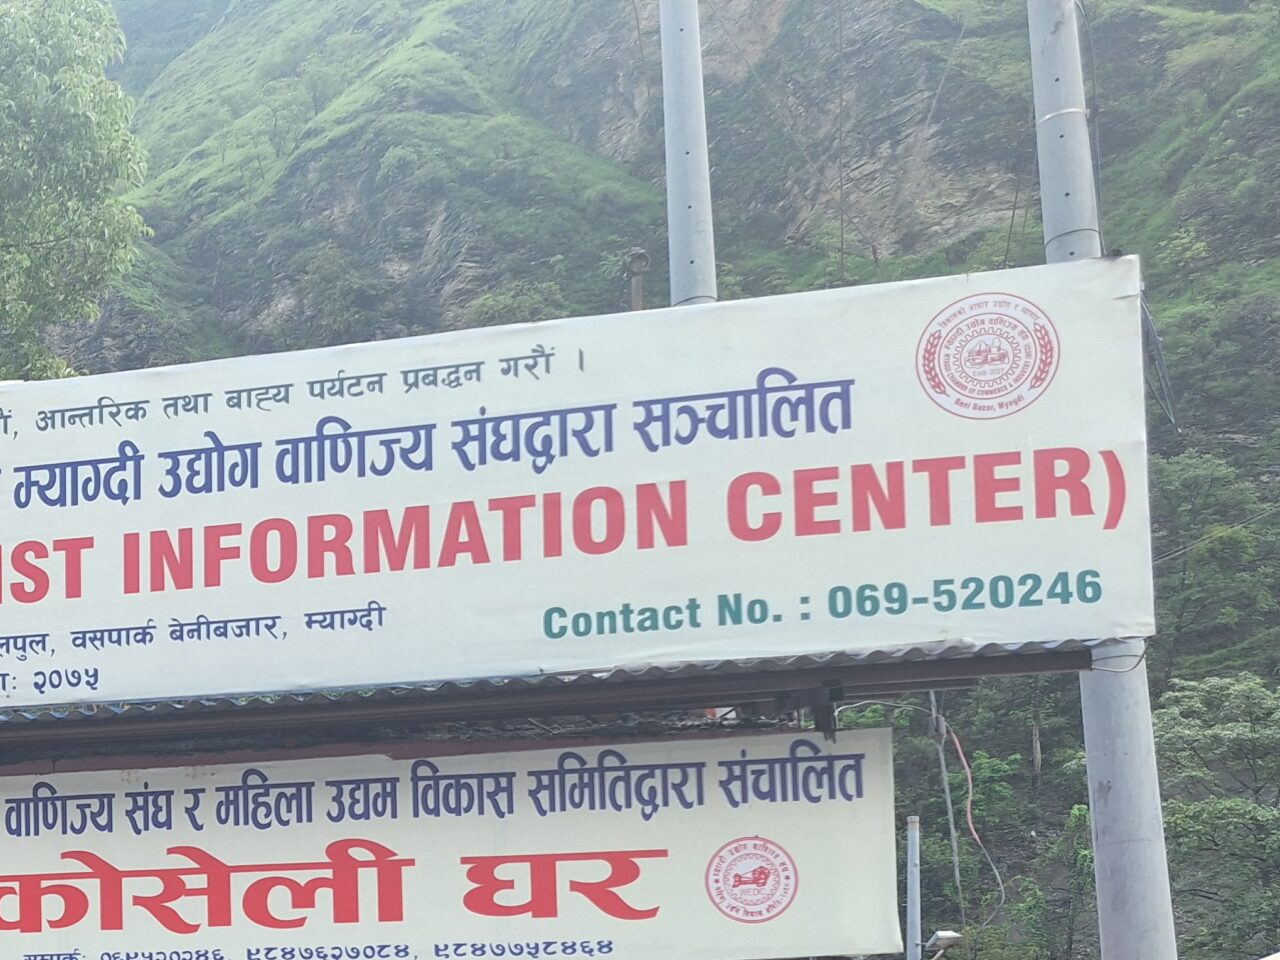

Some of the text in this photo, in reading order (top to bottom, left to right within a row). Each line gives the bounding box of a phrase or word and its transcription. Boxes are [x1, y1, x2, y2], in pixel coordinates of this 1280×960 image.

[36, 397, 150, 431] आन्तरिक
[162, 393, 212, 418] तथा
[225, 384, 293, 411] बाह्य
[307, 370, 387, 400] पर्यटन
[401, 362, 484, 393] प्रबद्धन
[499, 345, 554, 379] गरौं
[14, 440, 144, 508] म्याग्दी
[158, 431, 262, 498] उद्योग
[276, 416, 436, 484] वाणिज्य
[451, 404, 617, 474] संघद्वारा
[633, 368, 855, 452] सञ्चालित
[122, 480, 688, 595] INFORMATION
[728, 448, 1125, 541] CENTER)
[70, 619, 157, 650] वसपार्क
[168, 615, 287, 642] बेनीबजार,
[304, 601, 386, 631] म्याग्दी
[544, 598, 701, 639] Contact
[829, 570, 1101, 618] 069-520246
[34, 668, 98, 694] २०७५
[5, 782, 115, 836] वाणिज्य
[125, 781, 174, 835] संघ
[184, 788, 206, 831] र
[215, 768, 315, 829] महिला
[325, 777, 400, 822] उद्यम
[410, 757, 517, 819] विकास
[527, 749, 706, 820] समितिद्वारा
[718, 739, 865, 808] संचालित
[460, 849, 668, 920] घर
